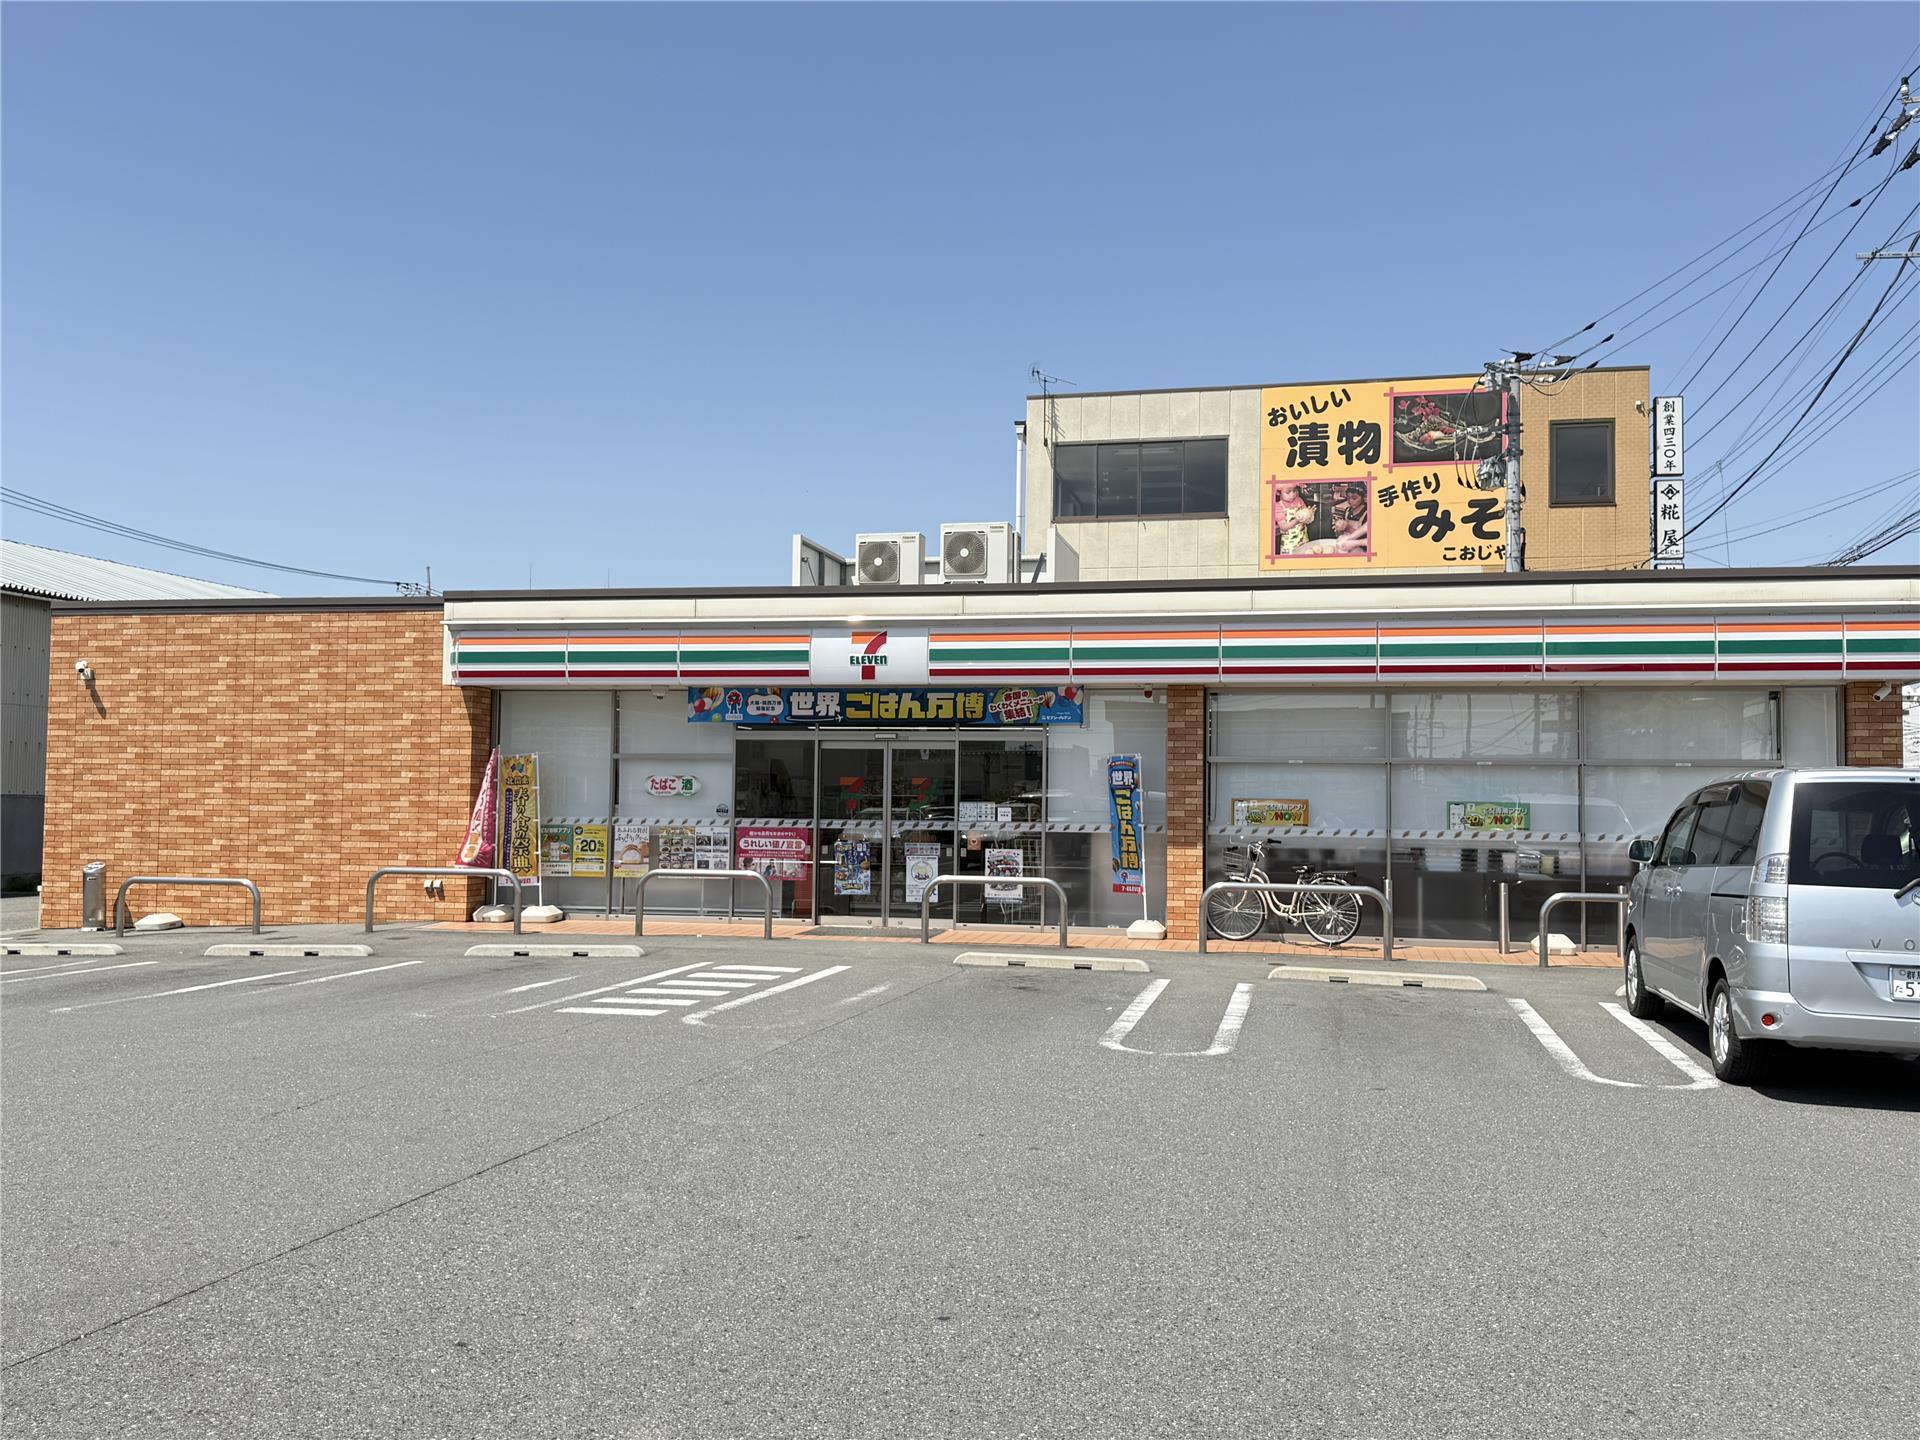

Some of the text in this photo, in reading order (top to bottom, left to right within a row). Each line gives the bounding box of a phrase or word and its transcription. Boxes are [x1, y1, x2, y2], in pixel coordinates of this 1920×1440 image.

[1268, 388, 1352, 427] おいしい
[1286, 420, 1382, 468] 漬物
[1663, 400, 1677, 472] 創業四三〇年
[1378, 473, 1441, 507] 手作り
[1408, 498, 1506, 542] みそ
[1660, 503, 1681, 548] 糀屋
[650, 778, 677, 790] たばこ
[681, 778, 693, 790] 酒
[1111, 771, 1134, 786] 世界
[512, 787, 531, 873] 春の食の祭典
[1906, 970, 1920, 980] 群
